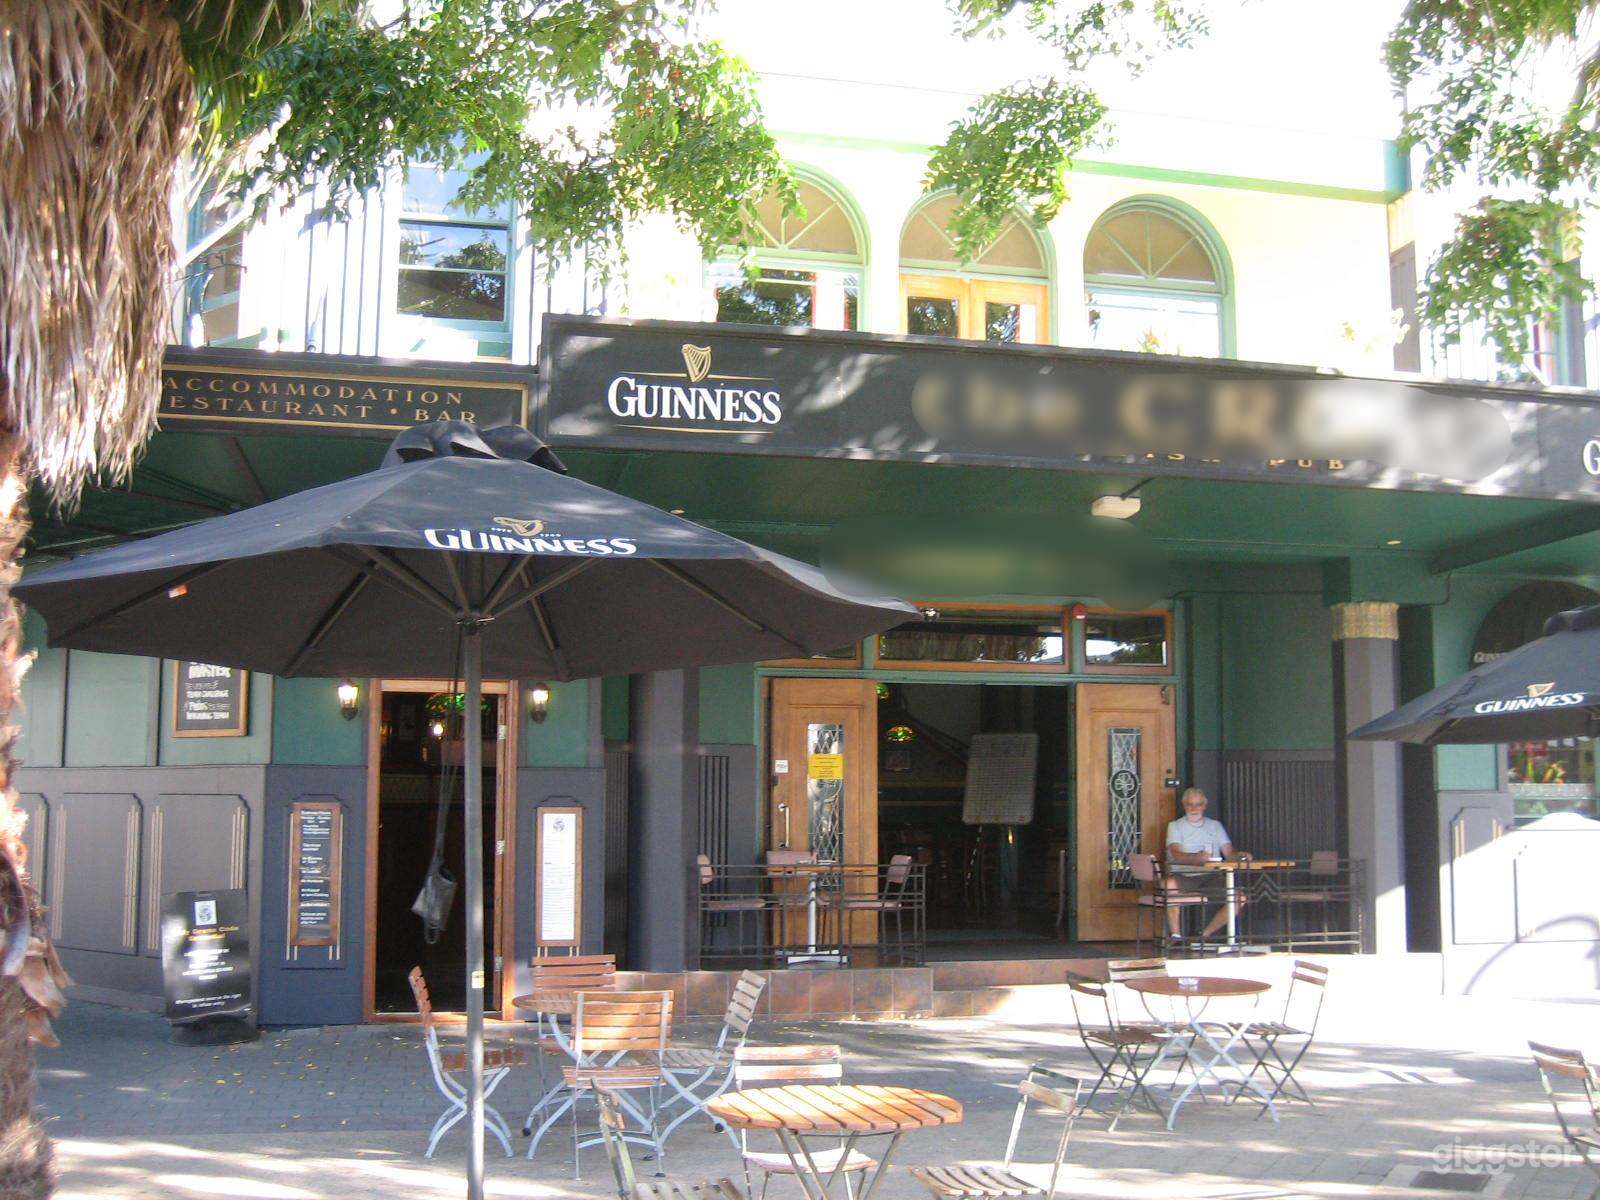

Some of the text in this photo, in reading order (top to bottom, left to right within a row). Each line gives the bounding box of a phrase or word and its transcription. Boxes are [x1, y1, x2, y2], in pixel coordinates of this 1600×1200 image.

[163, 376, 463, 405] ACCOMMODATION
[607, 376, 782, 425] GUINNESS
[169, 394, 477, 424] ESTAURANT BAR
[423, 528, 637, 556] GUINNESS
[1474, 692, 1585, 714] GUINNESS
